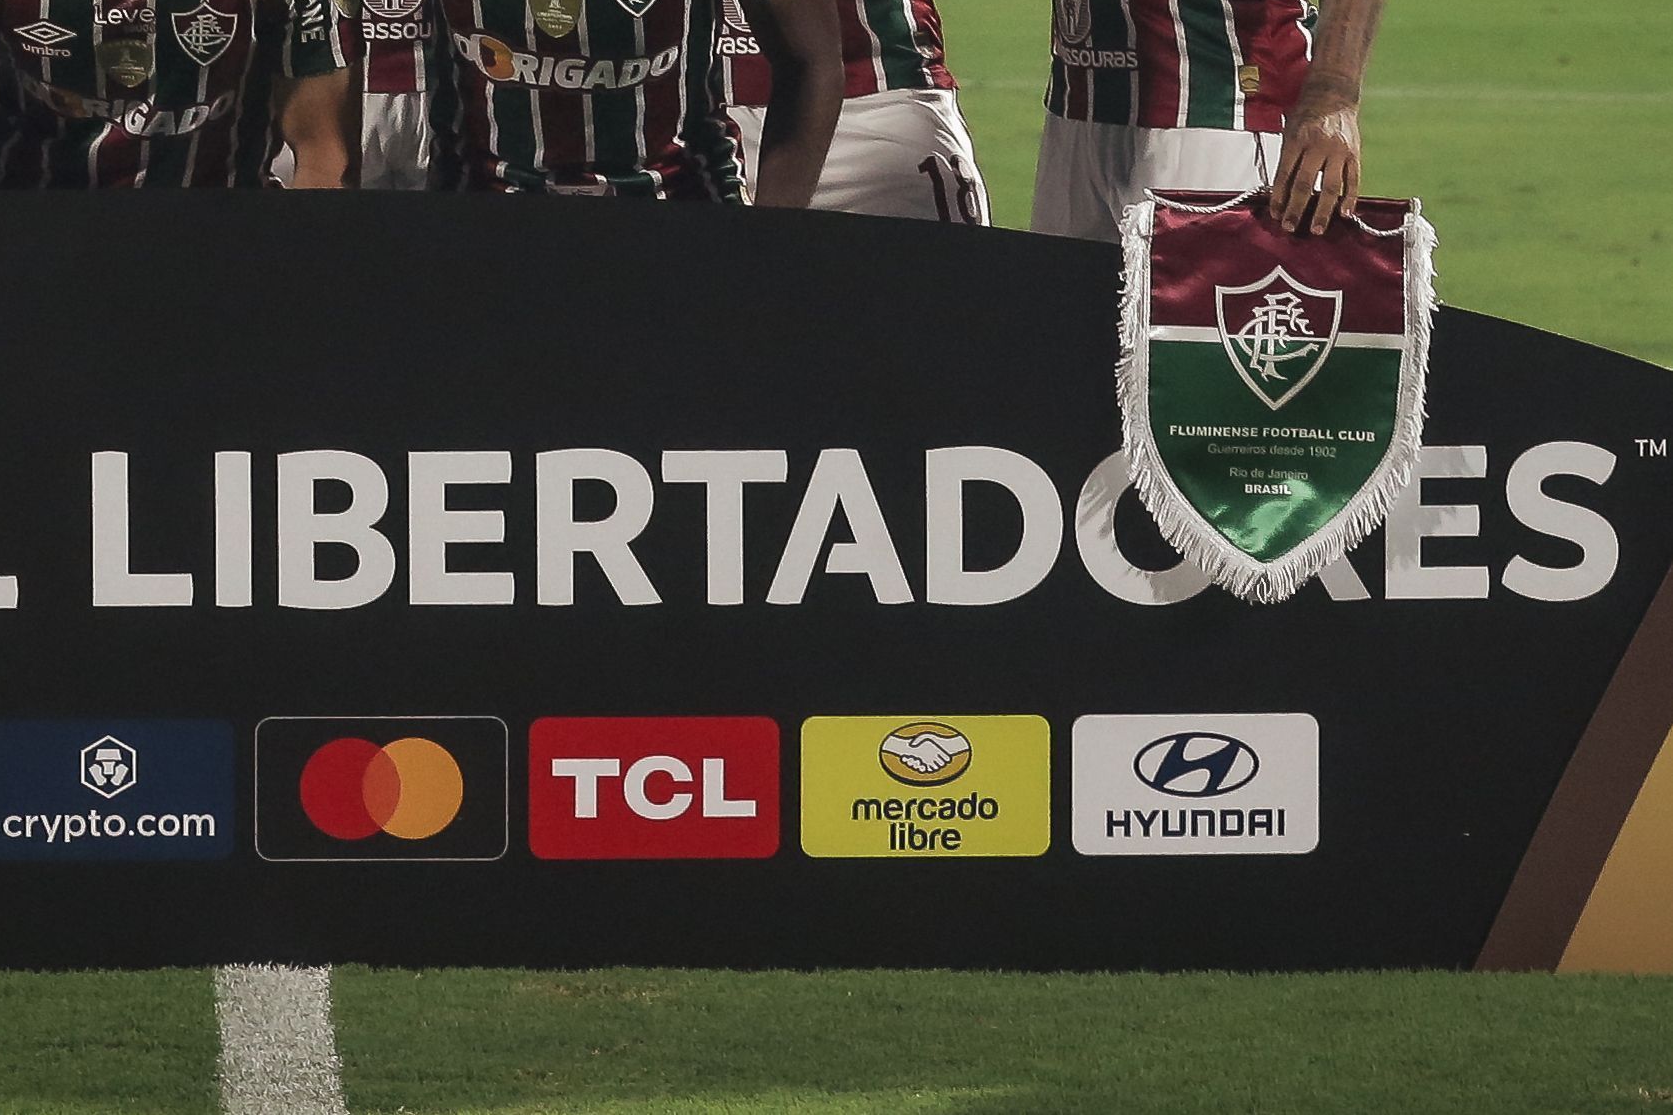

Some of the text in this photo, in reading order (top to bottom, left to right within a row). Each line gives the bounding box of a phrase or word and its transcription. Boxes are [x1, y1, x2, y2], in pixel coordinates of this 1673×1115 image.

[94, 5, 155, 25] Leve
[22, 42, 71, 58] umbro
[453, 33, 679, 90] OBRIGADO
[1169, 424, 1376, 443] FLUMINENSE FOOTBALL CLUB
[1207, 442, 1337, 458] Guerreiros desde 1902
[1228, 467, 1309, 481] Rio de Janeiro
[1244, 483, 1293, 496] BRASIL
[91, 439, 1619, 609] LIBERTADOES
[1634, 438, 1667, 457] TM
[551, 754, 757, 820] TCL
[851, 791, 999, 821] mercado
[2, 809, 216, 843] crypto.com
[888, 822, 963, 852] libre
[1105, 807, 1286, 838] HYUNDAI
